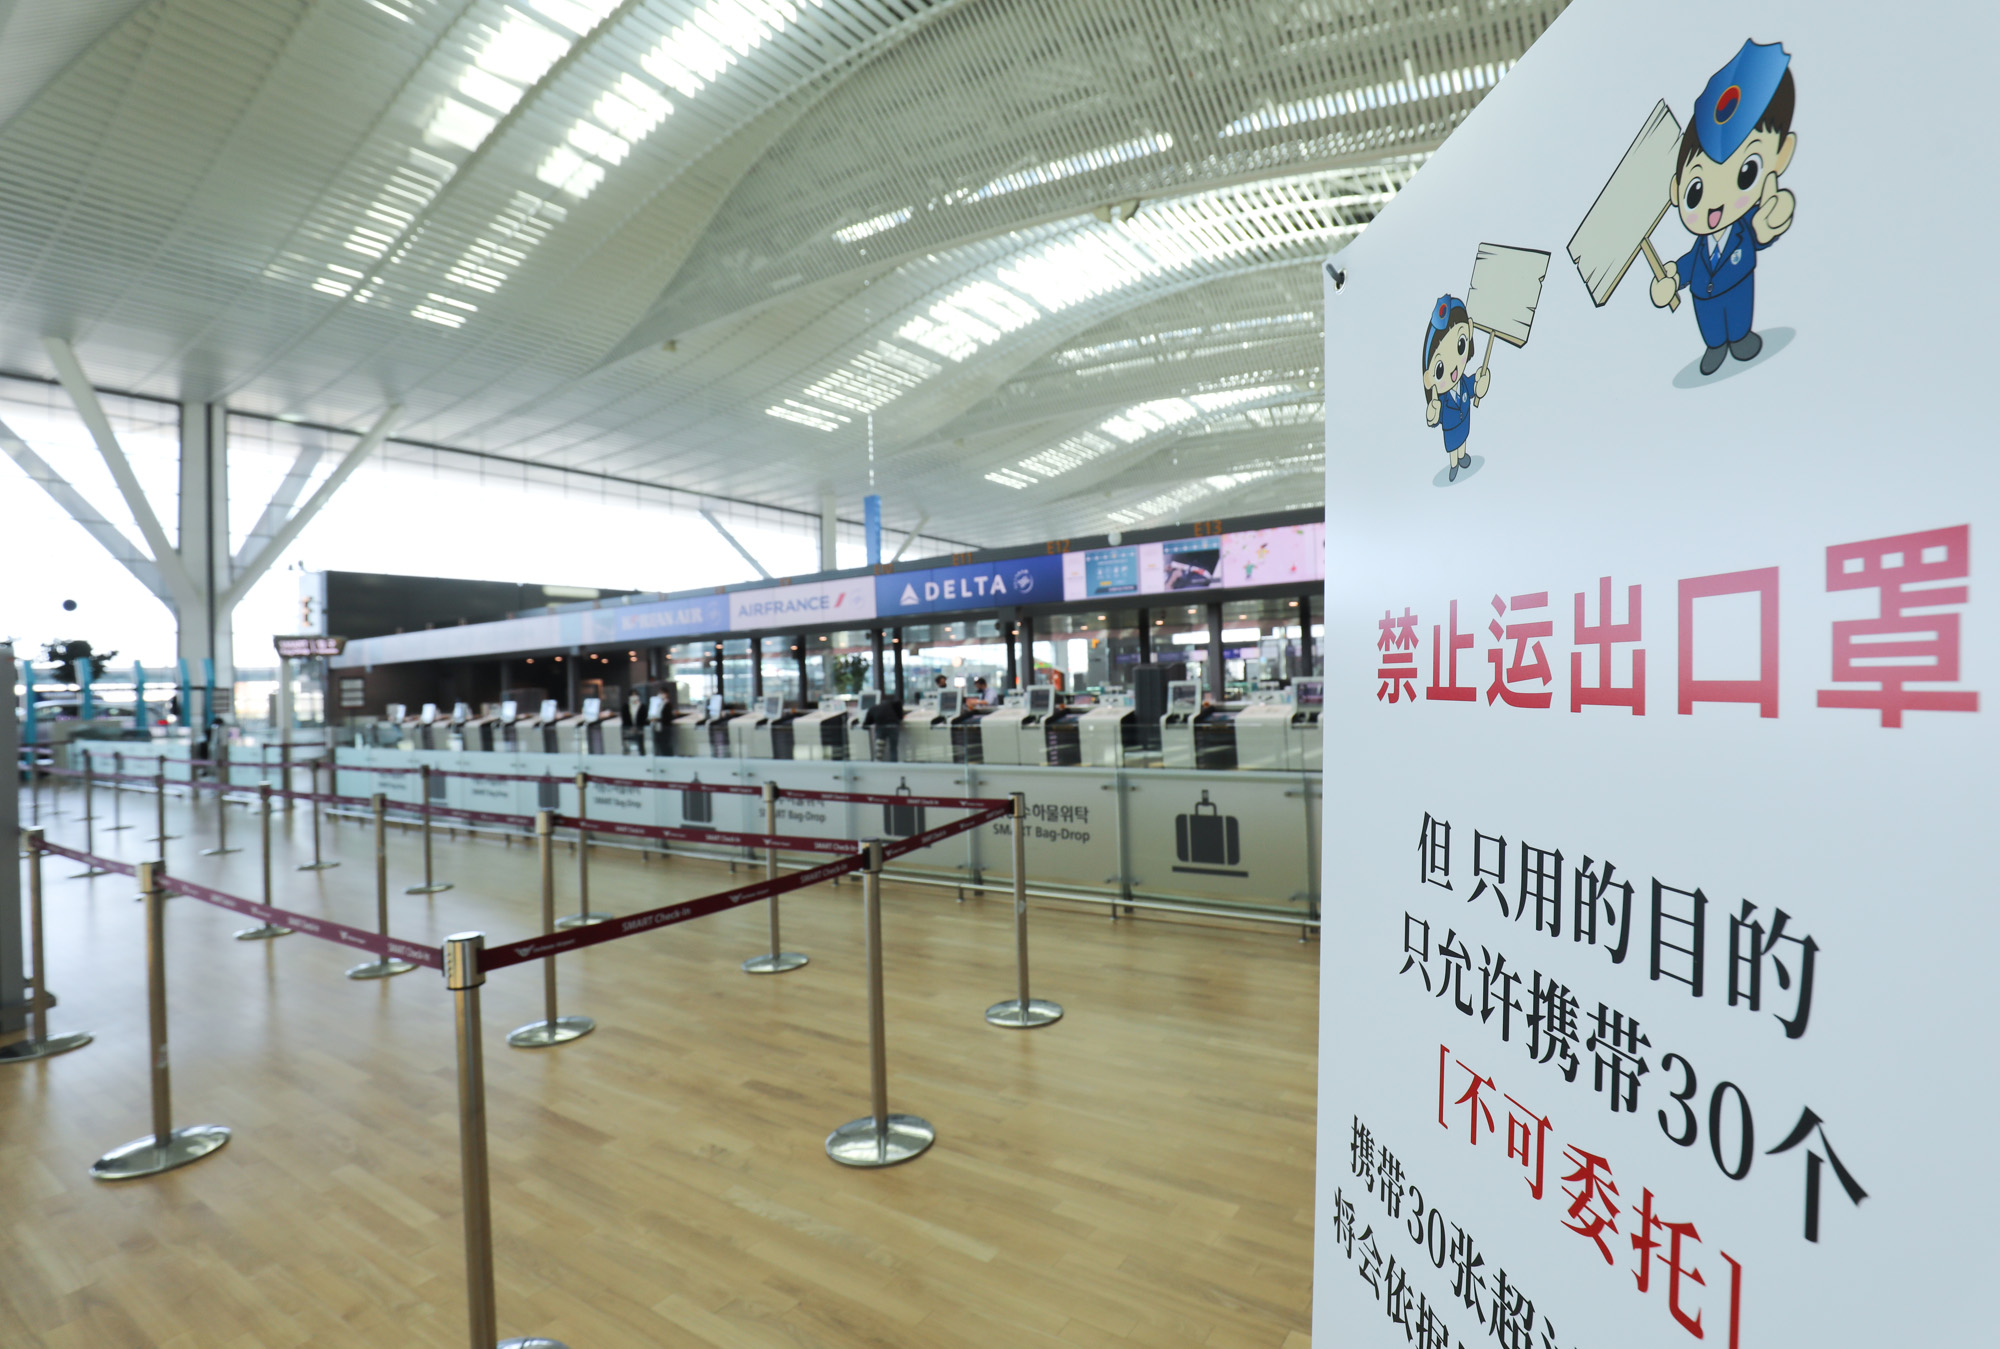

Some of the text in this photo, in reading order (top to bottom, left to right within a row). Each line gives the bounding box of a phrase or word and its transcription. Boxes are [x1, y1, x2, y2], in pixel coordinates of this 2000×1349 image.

[1194, 520, 1222, 537] E13
[953, 552, 973, 567] E11
[1047, 540, 1070, 555] E12
[925, 574, 1007, 602] DELTA
[737, 595, 831, 618] AIRFRANCE
[1376, 523, 1980, 729] 禁止运出口罩
[1036, 826, 1091, 844] Bag-Drop
[622, 915, 653, 932] SMART
[1417, 811, 1820, 1039] 但只用的目的
[1400, 911, 1869, 1243] 只允许携带30个
[1350, 1114, 1578, 1349] 携带30张超
[1334, 1187, 1468, 1349] 将会依据
